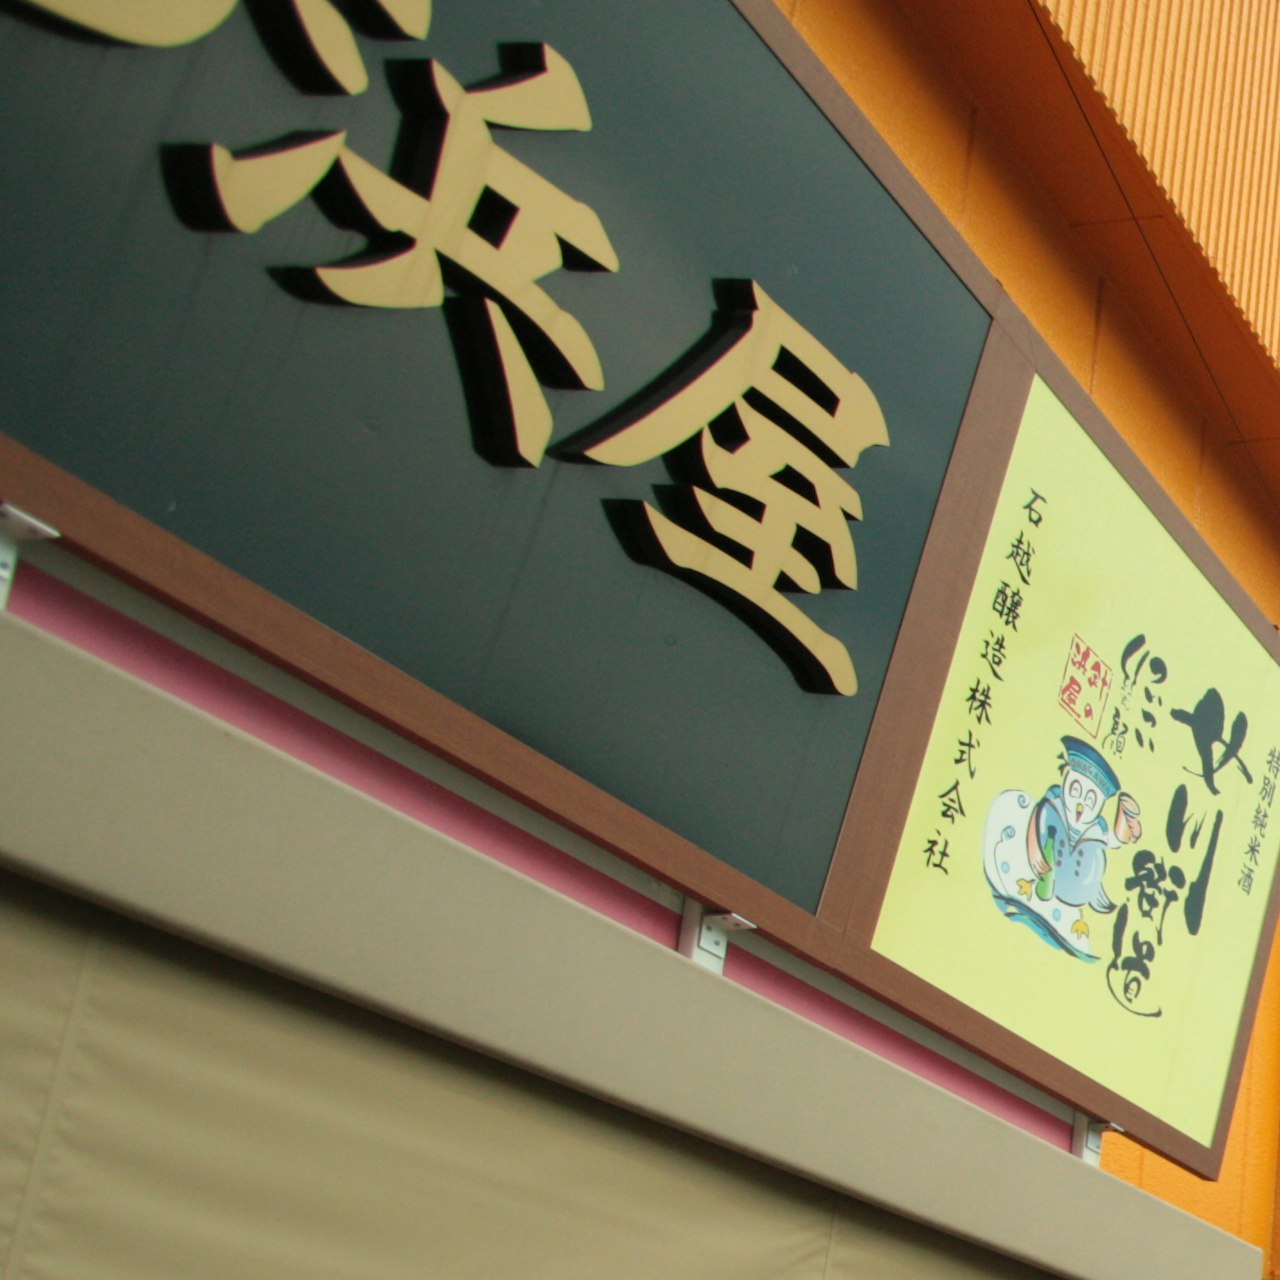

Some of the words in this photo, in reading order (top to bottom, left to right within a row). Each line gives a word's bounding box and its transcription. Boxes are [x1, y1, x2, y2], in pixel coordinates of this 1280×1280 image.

[0, 0, 890, 697] 浜屋
[922, 488, 1047, 875] 石越醸造株式会社
[1106, 688, 1253, 1017] 女川街道
